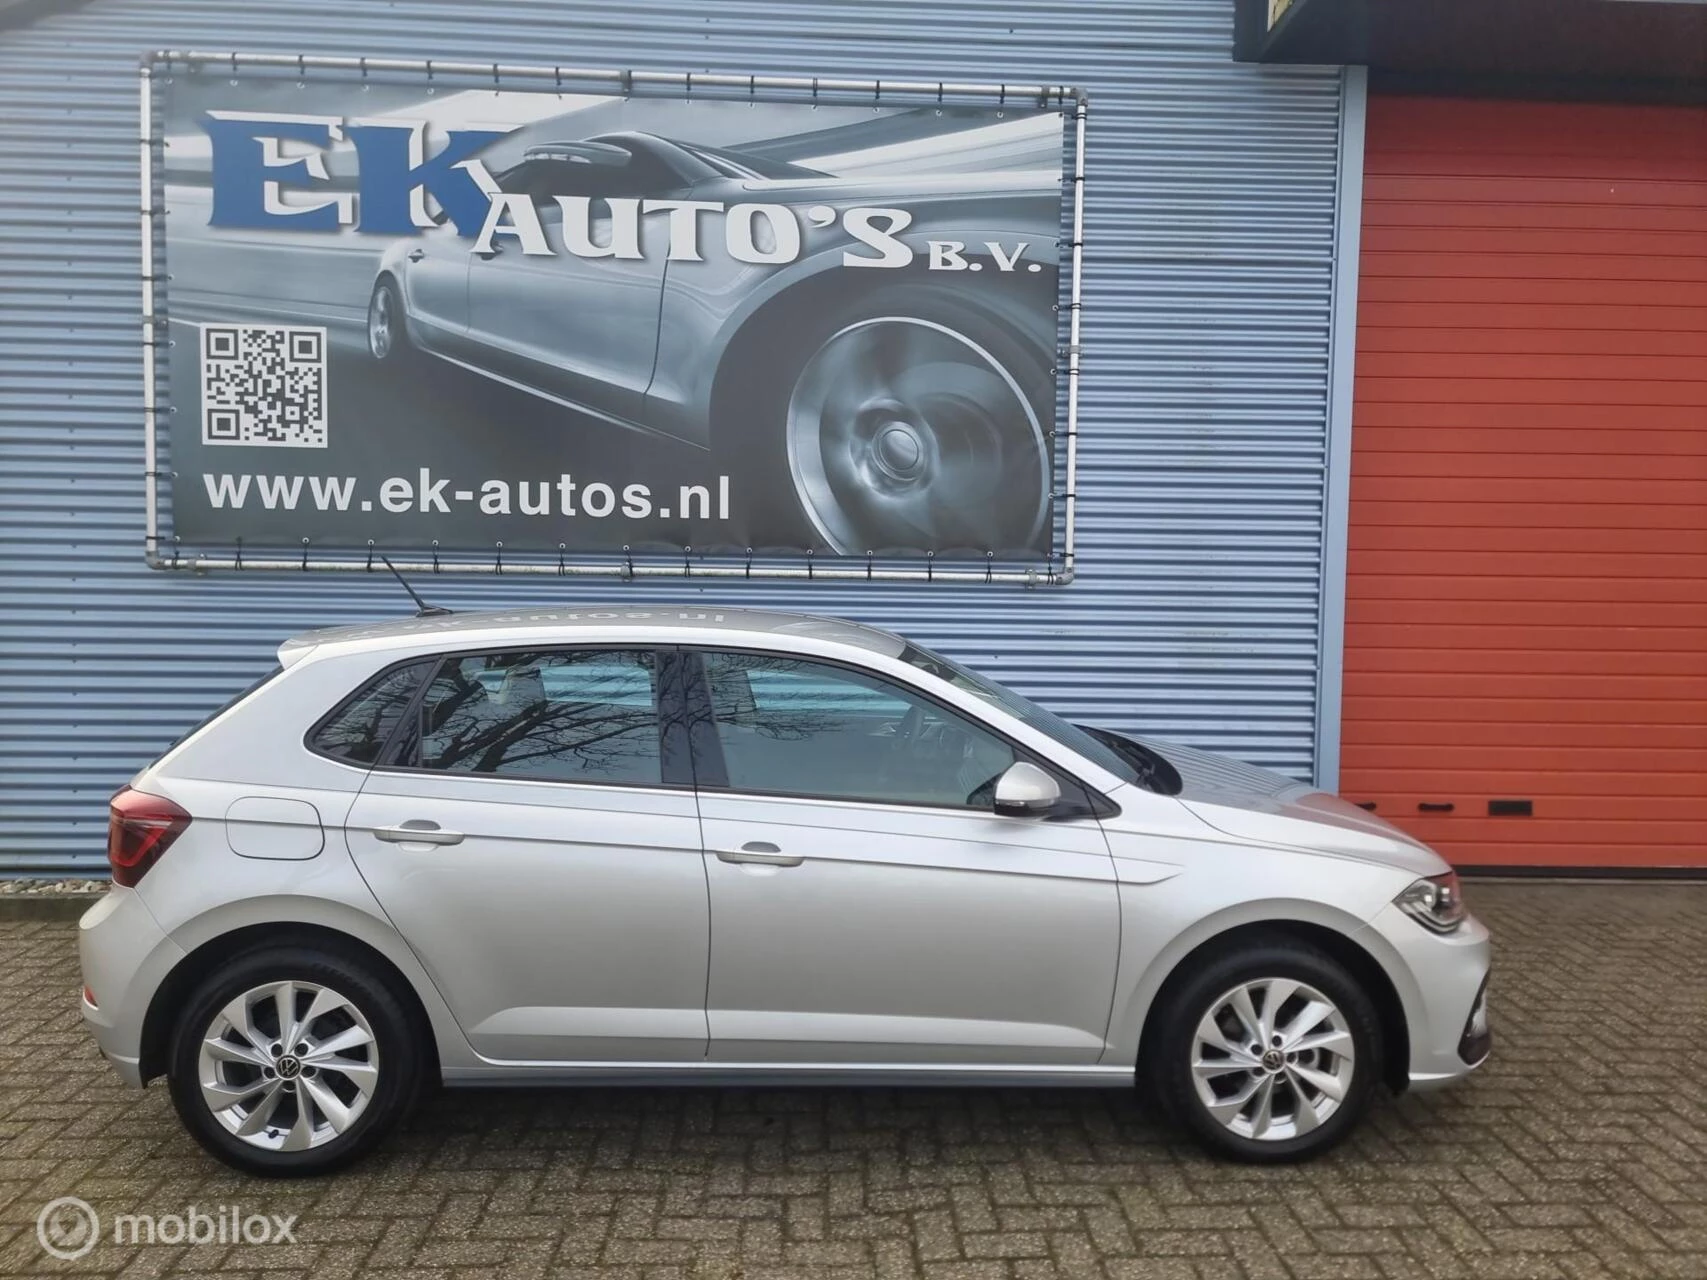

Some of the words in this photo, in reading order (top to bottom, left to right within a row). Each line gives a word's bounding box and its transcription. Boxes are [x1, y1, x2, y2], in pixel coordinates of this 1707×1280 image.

[201, 110, 526, 238] EK
[927, 240, 1042, 272] B.V.
[202, 467, 731, 520] www.ek-autos.nl
